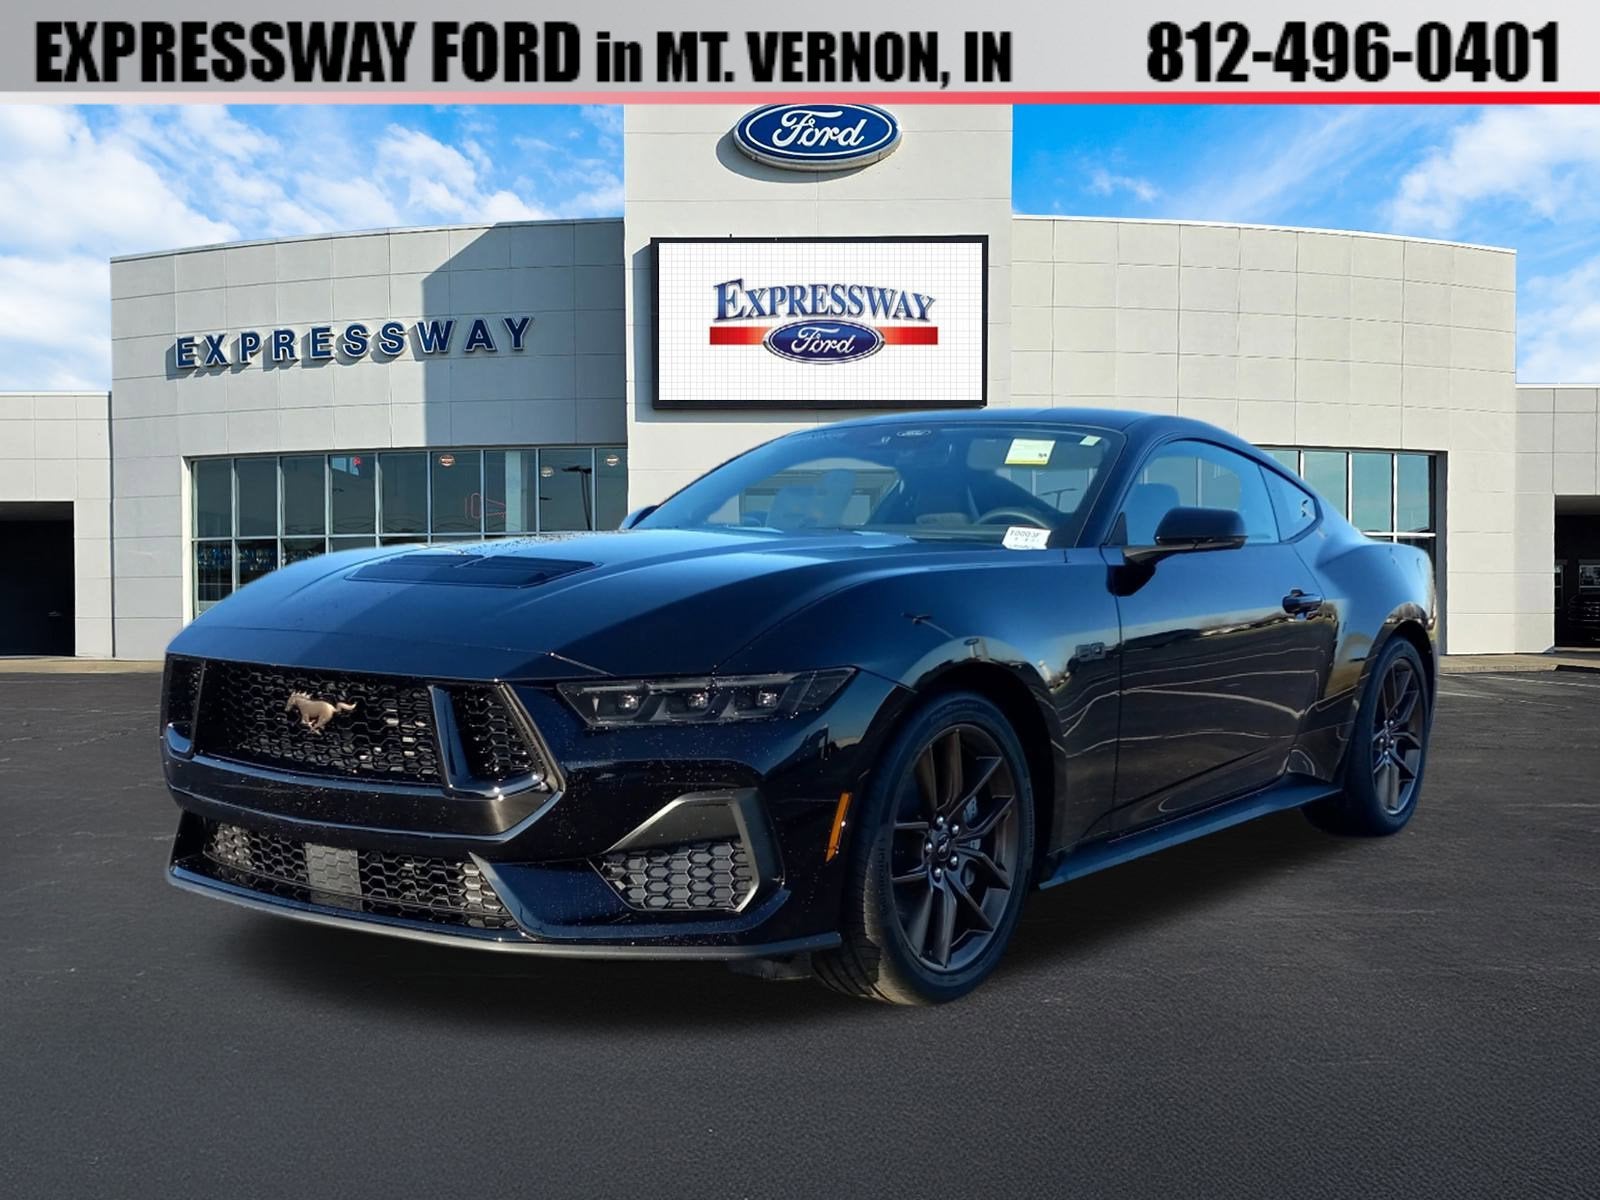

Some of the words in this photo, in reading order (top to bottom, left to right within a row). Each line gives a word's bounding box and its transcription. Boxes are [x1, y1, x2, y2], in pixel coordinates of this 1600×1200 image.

[772, 110, 867, 147] Ford
[175, 316, 533, 368] EXPRESSWAY
[791, 326, 855, 353] Ford
